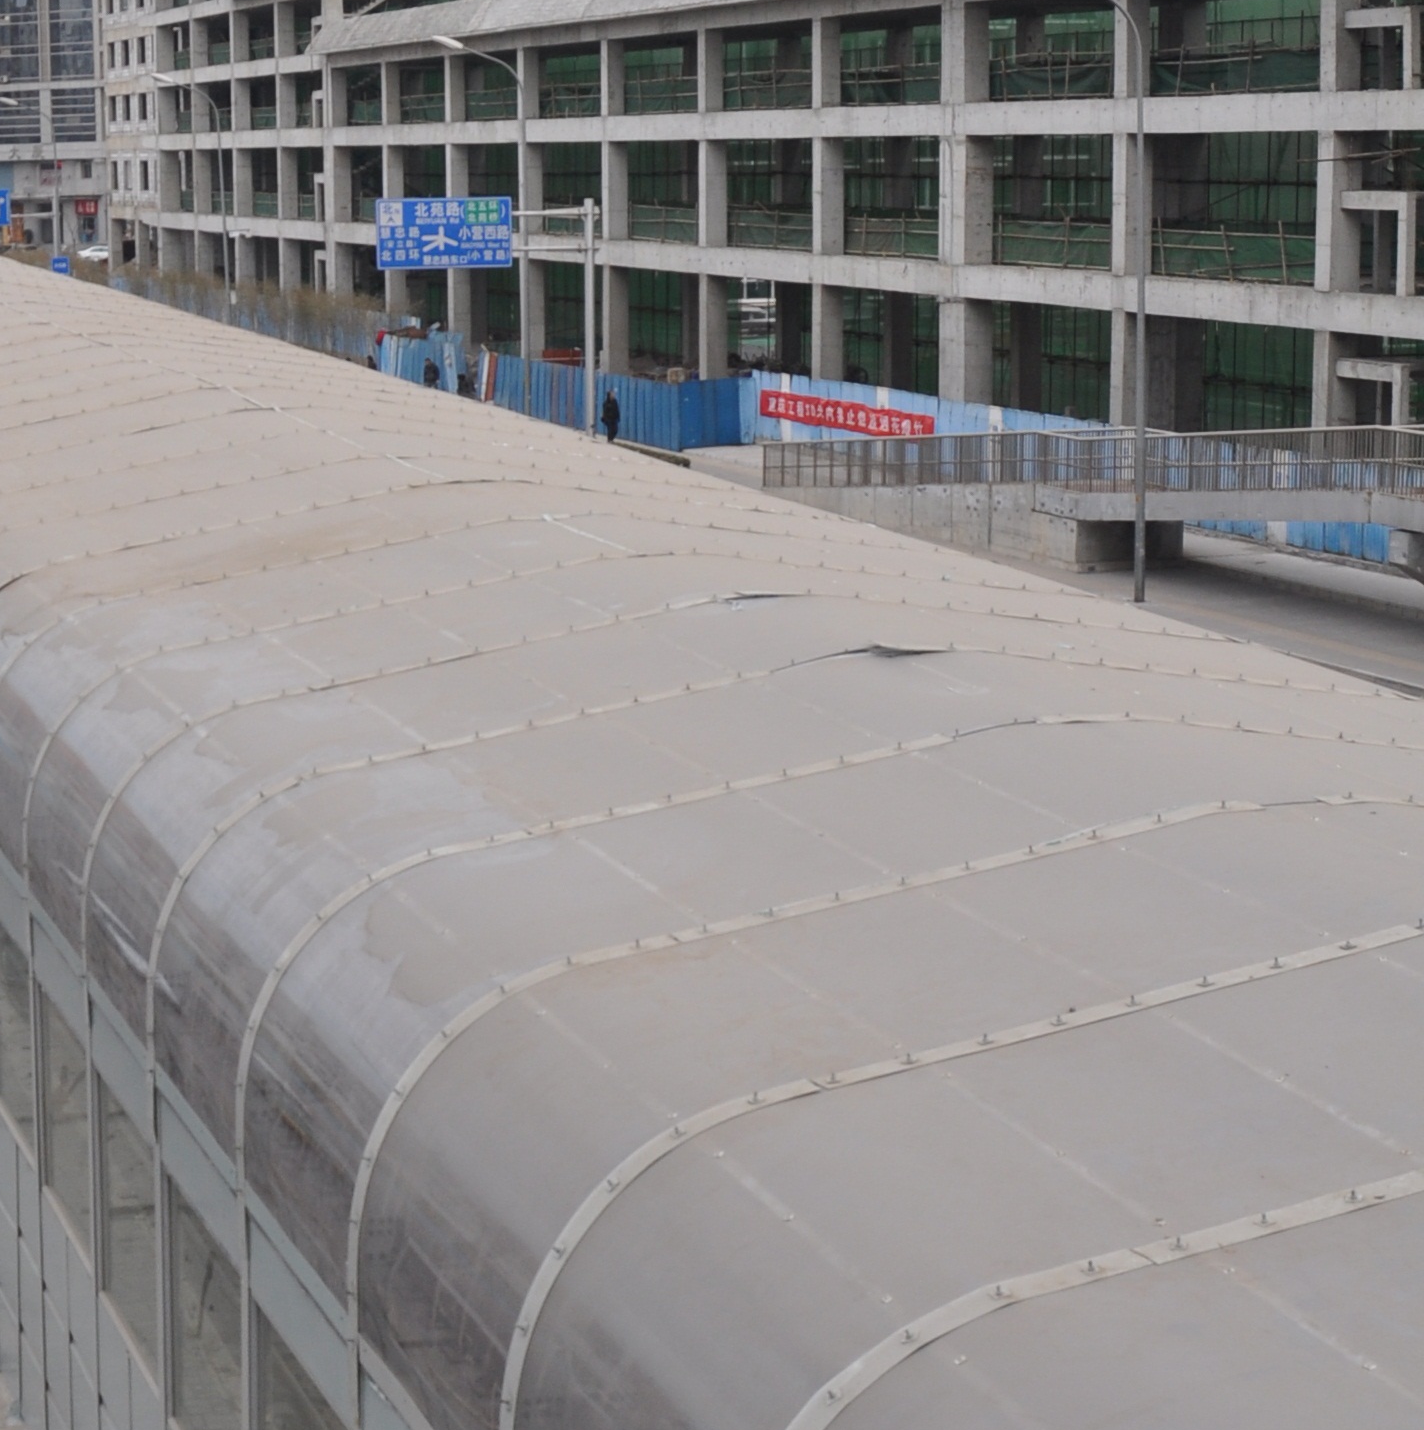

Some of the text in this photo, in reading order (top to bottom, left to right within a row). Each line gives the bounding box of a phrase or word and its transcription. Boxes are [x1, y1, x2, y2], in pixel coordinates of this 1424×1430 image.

[414, 202, 460, 217] 北苑路
[458, 224, 510, 240] 小营西路
[381, 249, 420, 261] 北四环
